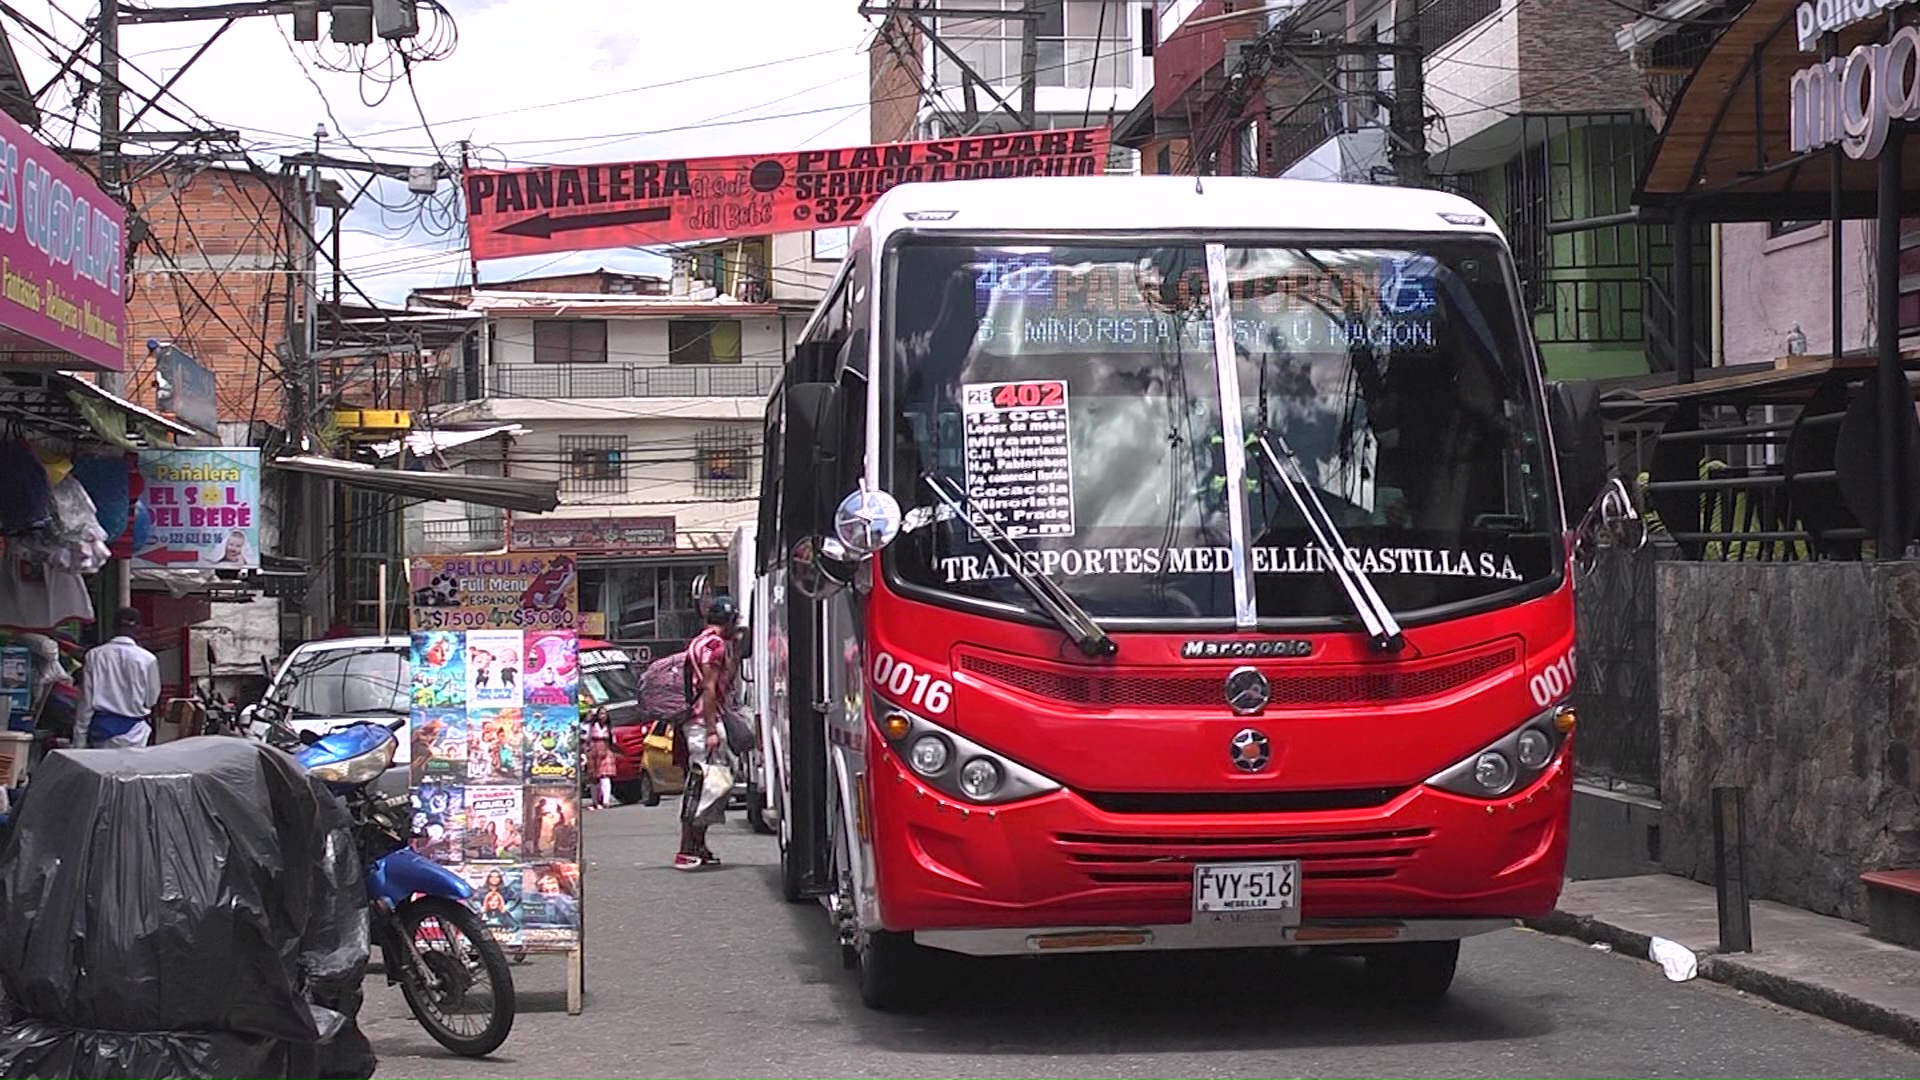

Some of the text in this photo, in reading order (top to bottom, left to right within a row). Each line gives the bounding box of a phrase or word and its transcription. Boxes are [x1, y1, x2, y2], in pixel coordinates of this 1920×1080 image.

[796, 129, 1094, 173] PLAN SEPARE
[796, 165, 922, 201] SERVICIO
[954, 156, 1096, 179] DOMICILIO
[815, 194, 881, 224] 32
[22, 157, 120, 296] GUADALUPE
[1025, 318, 1171, 344] MINORISTA
[1198, 319, 1267, 343] ESY
[994, 383, 1064, 407] 402
[967, 410, 1066, 424] 12 Oct.
[968, 436, 1066, 448] Miramar
[993, 446, 1067, 458] Bolivariana
[157, 463, 240, 482] Pañalera
[149, 486, 178, 505] EL
[970, 482, 1068, 498] Cocacola
[970, 496, 1069, 509] Minorista
[189, 501, 250, 527] BEBÉ
[1013, 508, 1069, 522] Prado
[168, 533, 183, 544] 322
[941, 547, 1161, 583] TRANSPORTES
[1343, 547, 1476, 577] CASTILLA
[1479, 552, 1524, 581] S.A.
[459, 578, 485, 592] Full
[873, 651, 953, 714] 0016
[467, 761, 492, 778] LUCA
